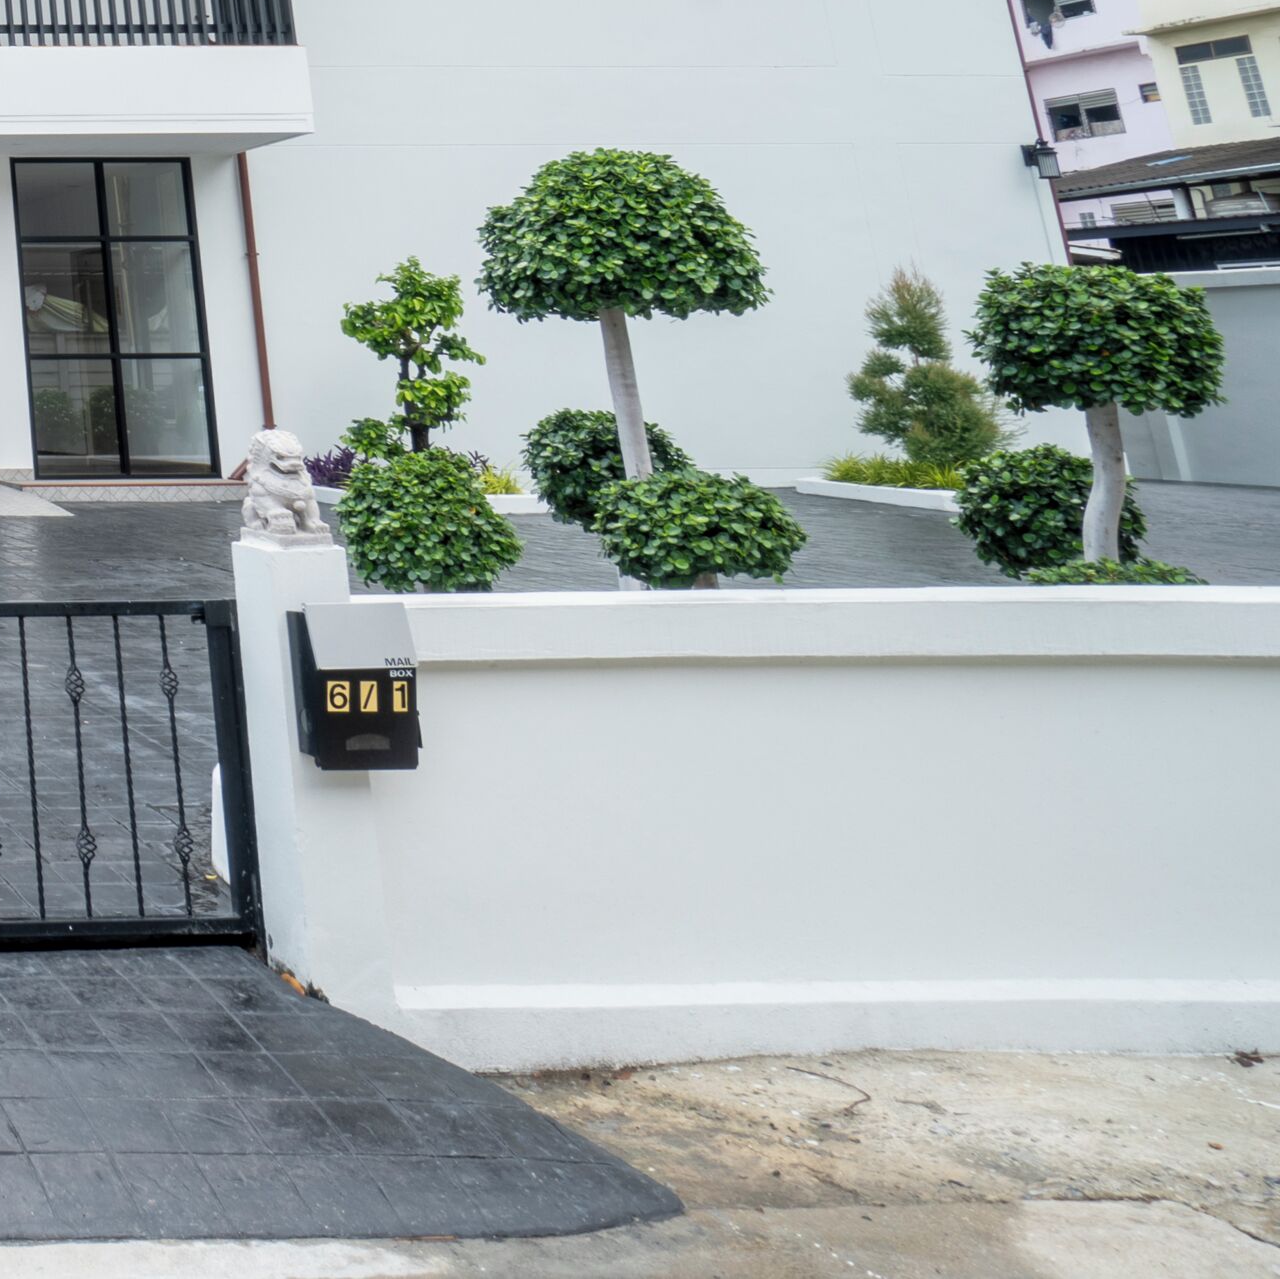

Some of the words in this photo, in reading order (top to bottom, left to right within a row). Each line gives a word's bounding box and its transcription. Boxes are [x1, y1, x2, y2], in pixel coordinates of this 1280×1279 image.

[384, 657, 415, 666] MAIL
[389, 669, 414, 678] BOX
[329, 683, 407, 710] 6/1
